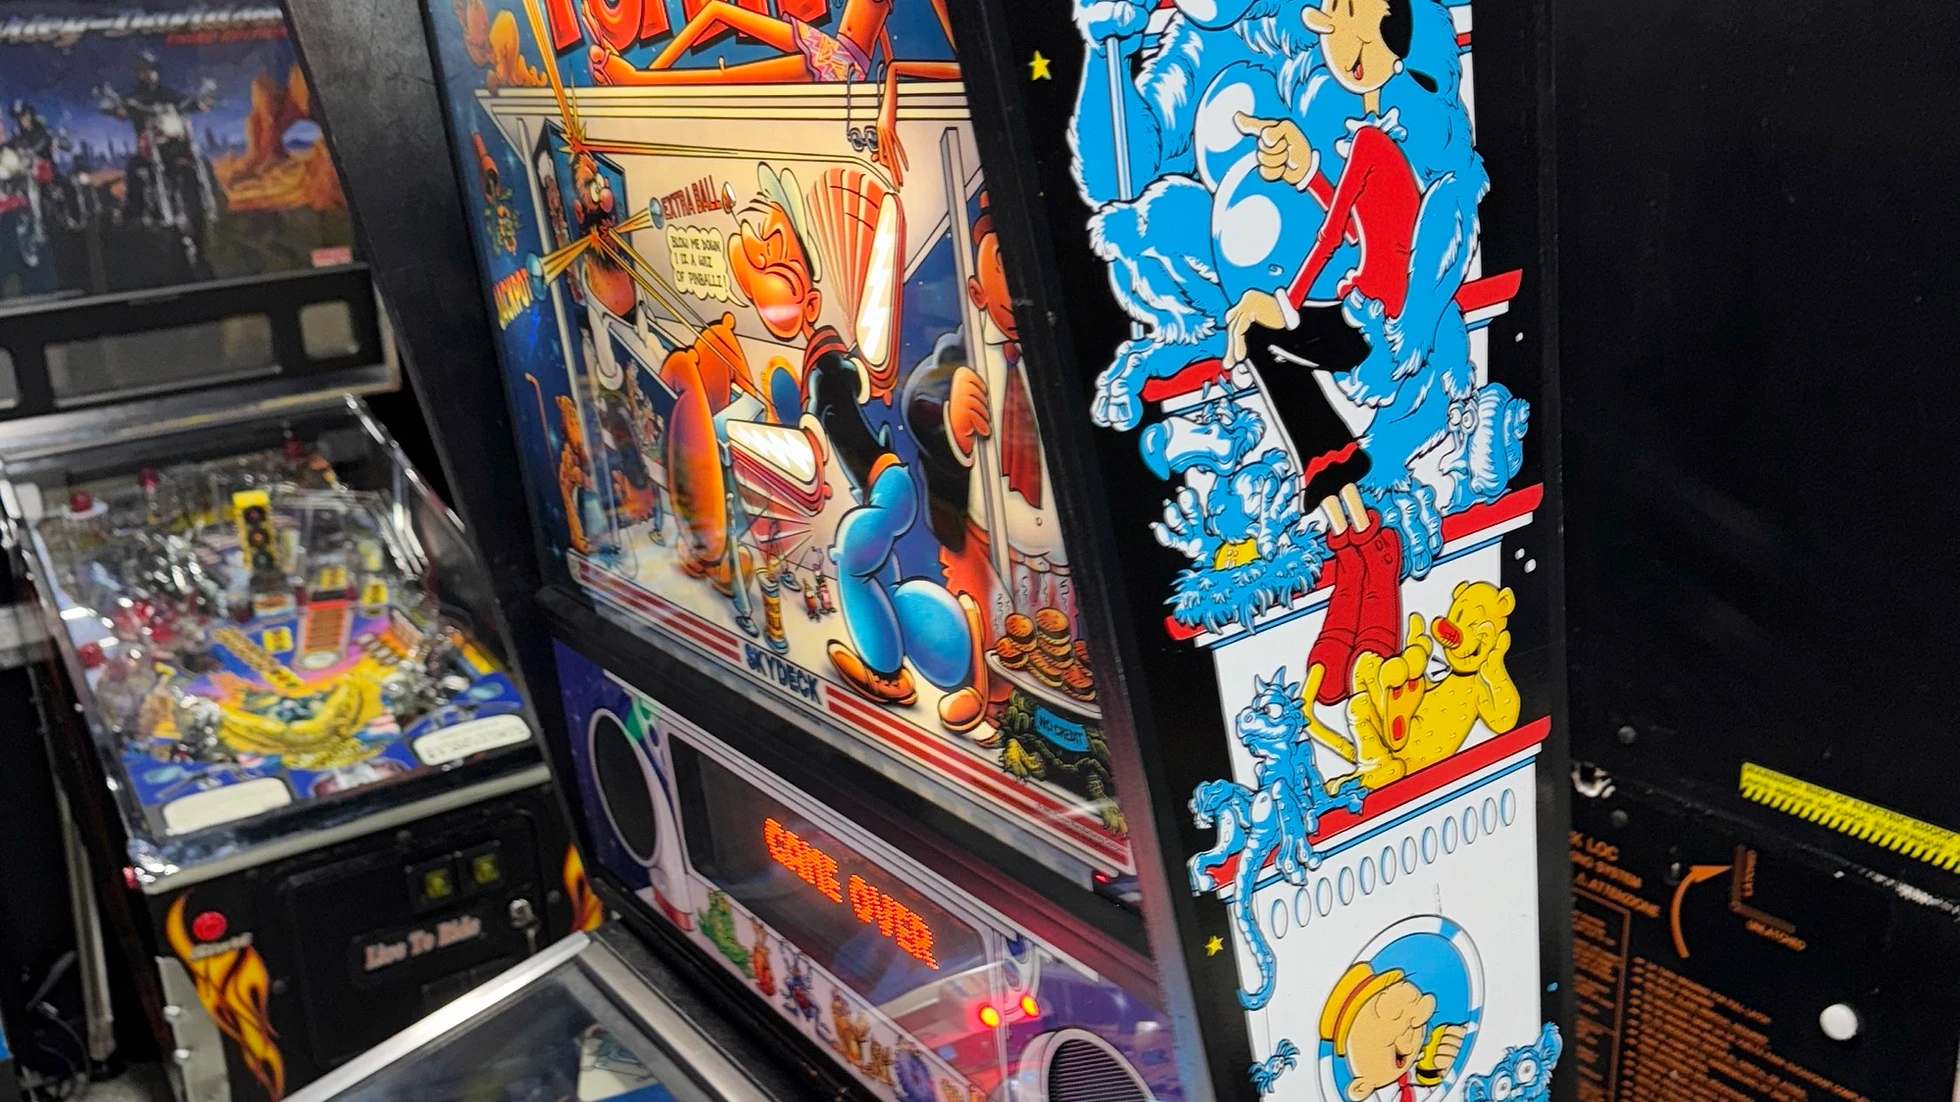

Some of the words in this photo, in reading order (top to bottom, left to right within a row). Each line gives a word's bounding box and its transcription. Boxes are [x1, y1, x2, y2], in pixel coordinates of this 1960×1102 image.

[661, 186, 696, 220] EXTRA
[691, 174, 722, 214] BALL
[671, 235, 689, 249] BLOW
[690, 238, 700, 250] ME
[492, 267, 534, 331] JACKPOT
[676, 270, 685, 282] OF
[745, 643, 822, 706] SKYDECK
[1040, 715, 1052, 730] NO
[1053, 725, 1084, 745] CREDIT
[764, 818, 843, 904] GAME
[848, 874, 939, 970] OVER
[365, 942, 407, 971] Live
[408, 929, 435, 956] To
[437, 914, 481, 946] Ride
